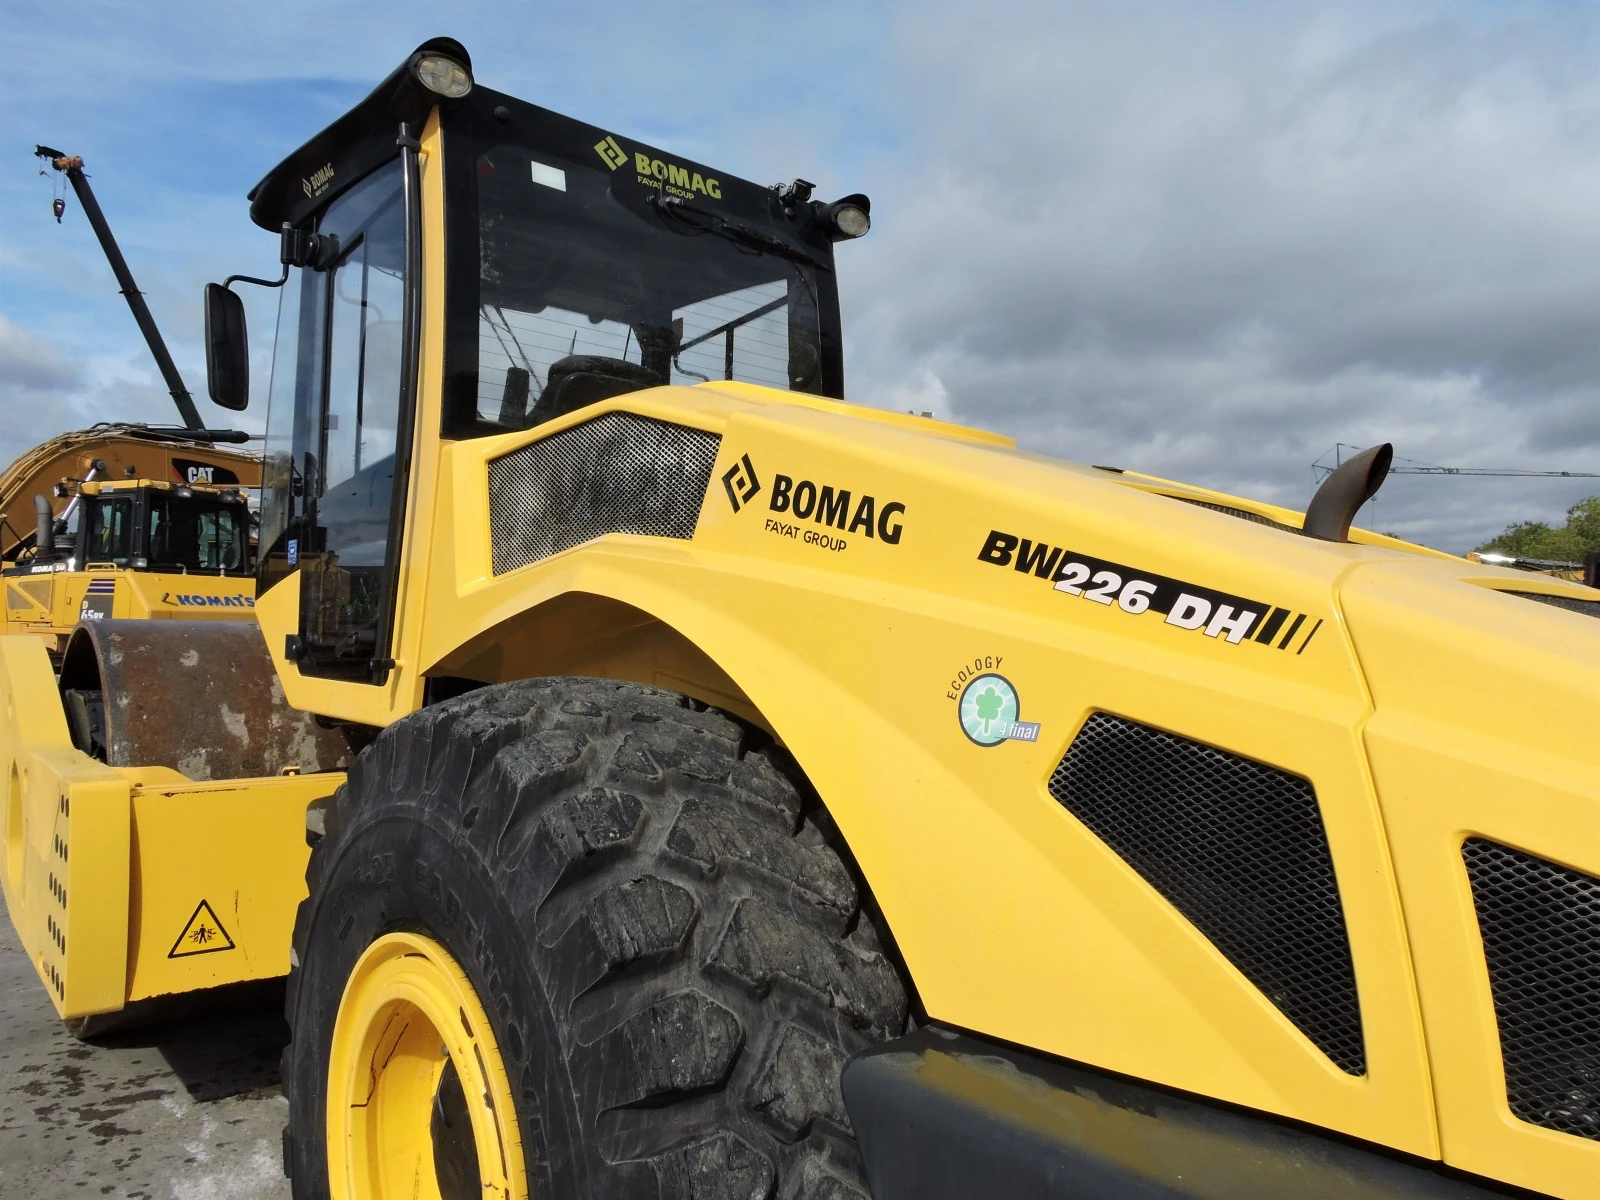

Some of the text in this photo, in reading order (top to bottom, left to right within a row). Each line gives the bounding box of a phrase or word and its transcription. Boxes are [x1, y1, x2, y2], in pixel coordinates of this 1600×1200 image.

[310, 162, 335, 190] BOMAG
[634, 151, 722, 199] BOMAG
[637, 175, 695, 200] FAYAT GROUP
[187, 466, 214, 484] CAT
[769, 473, 906, 545] BOMAG
[764, 518, 847, 553] FAYAT GROUP
[31, 564, 66, 573] KOMASU
[175, 593, 256, 607] KOMATS
[1164, 592, 1257, 646] DH
[946, 655, 1003, 701] ECOLOGY
[999, 722, 1038, 740] 4 final
